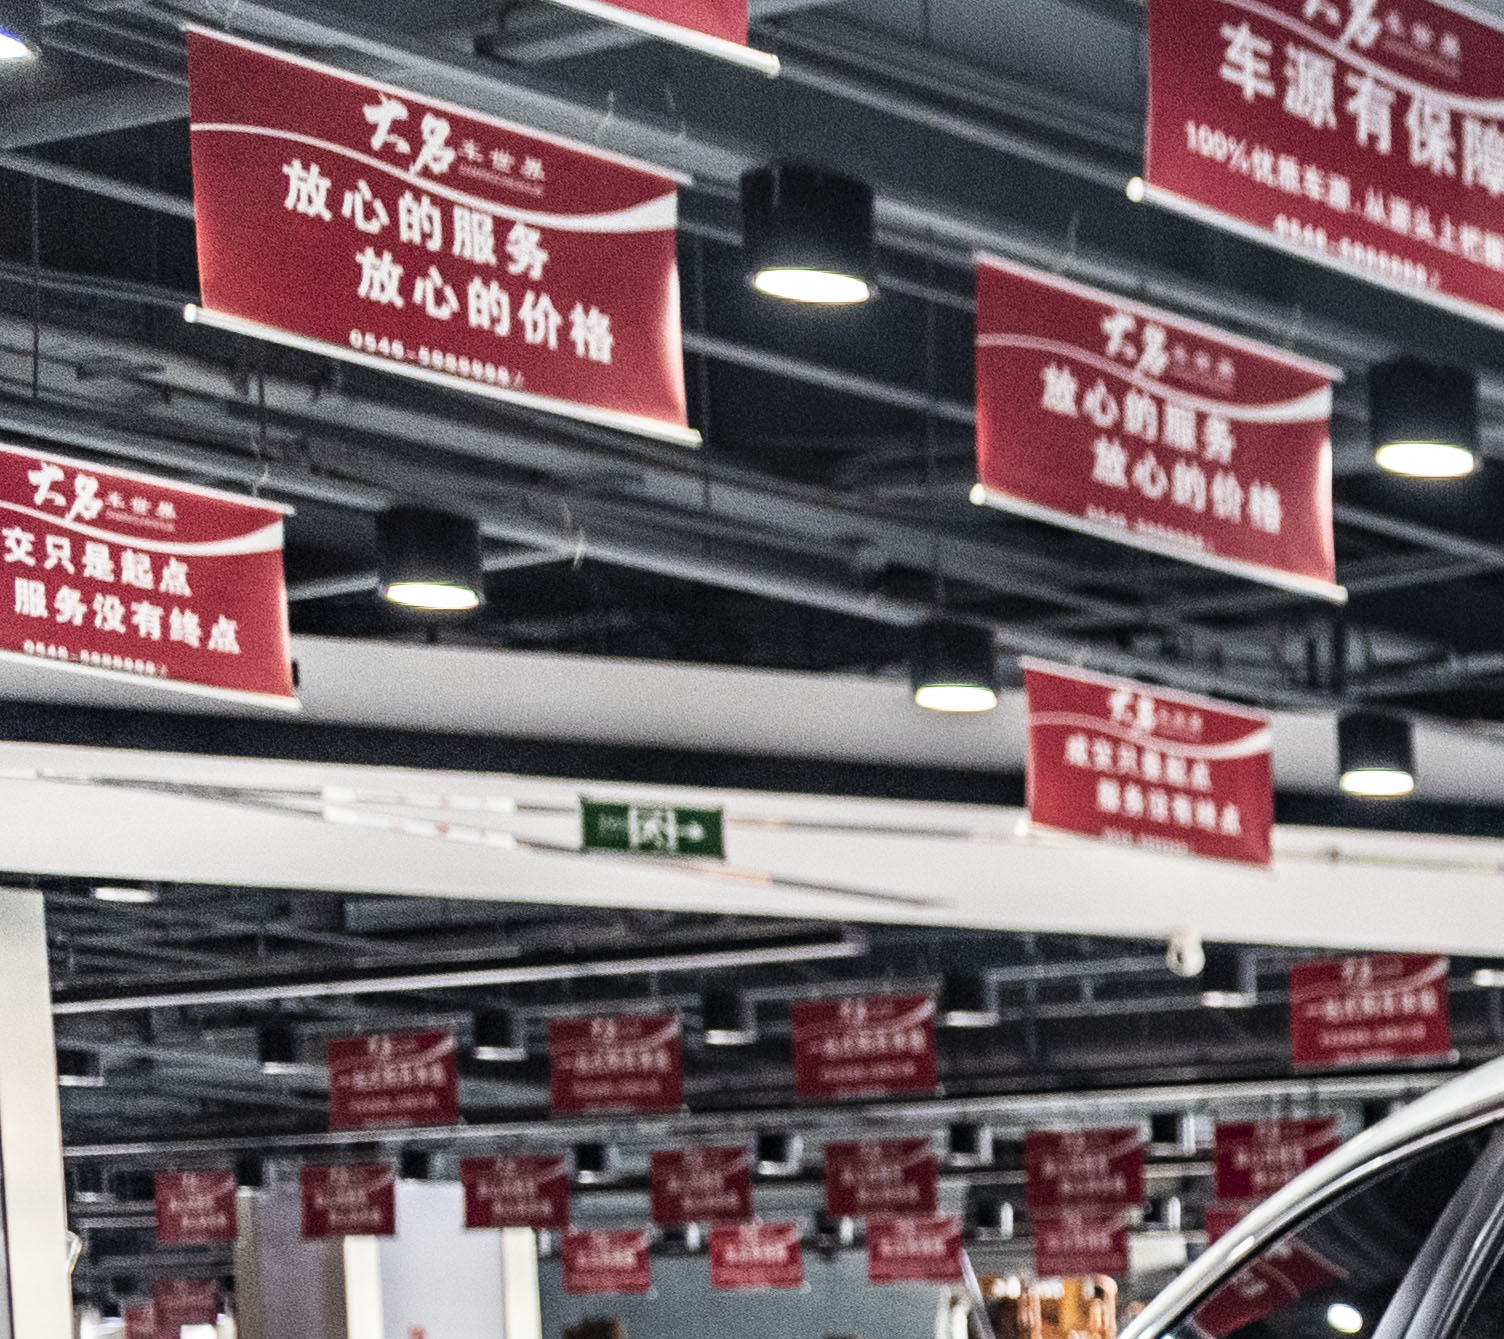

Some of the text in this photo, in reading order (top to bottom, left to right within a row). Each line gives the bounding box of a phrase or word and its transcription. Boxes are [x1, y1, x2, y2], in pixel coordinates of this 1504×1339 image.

[281, 158, 549, 281] 放心的服务
[355, 246, 615, 365] 放心的价格
[1040, 361, 1235, 466] 放心的服务
[1092, 433, 1283, 536] 放心的价格
[2, 525, 193, 598] 交只是起点
[13, 576, 242, 656] 服务没有终点
